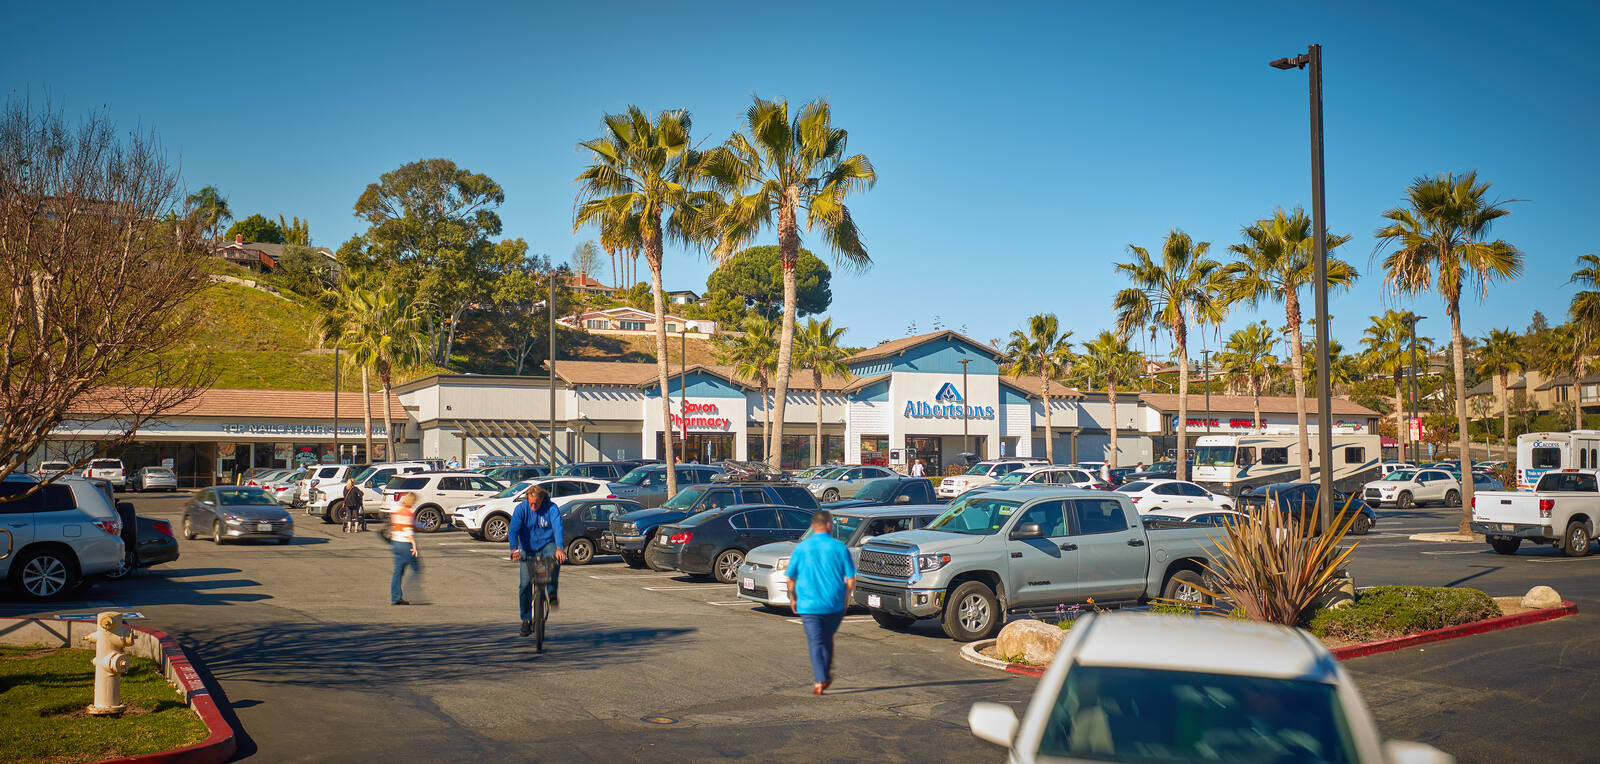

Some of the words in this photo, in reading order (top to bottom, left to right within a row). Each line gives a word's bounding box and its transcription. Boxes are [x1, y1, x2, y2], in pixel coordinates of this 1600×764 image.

[904, 400, 995, 419] Albertsons
[223, 424, 245, 432] TOP
[249, 424, 284, 433] NAILS
[295, 424, 325, 433] HAIR
[670, 413, 730, 431] Pharmacy
